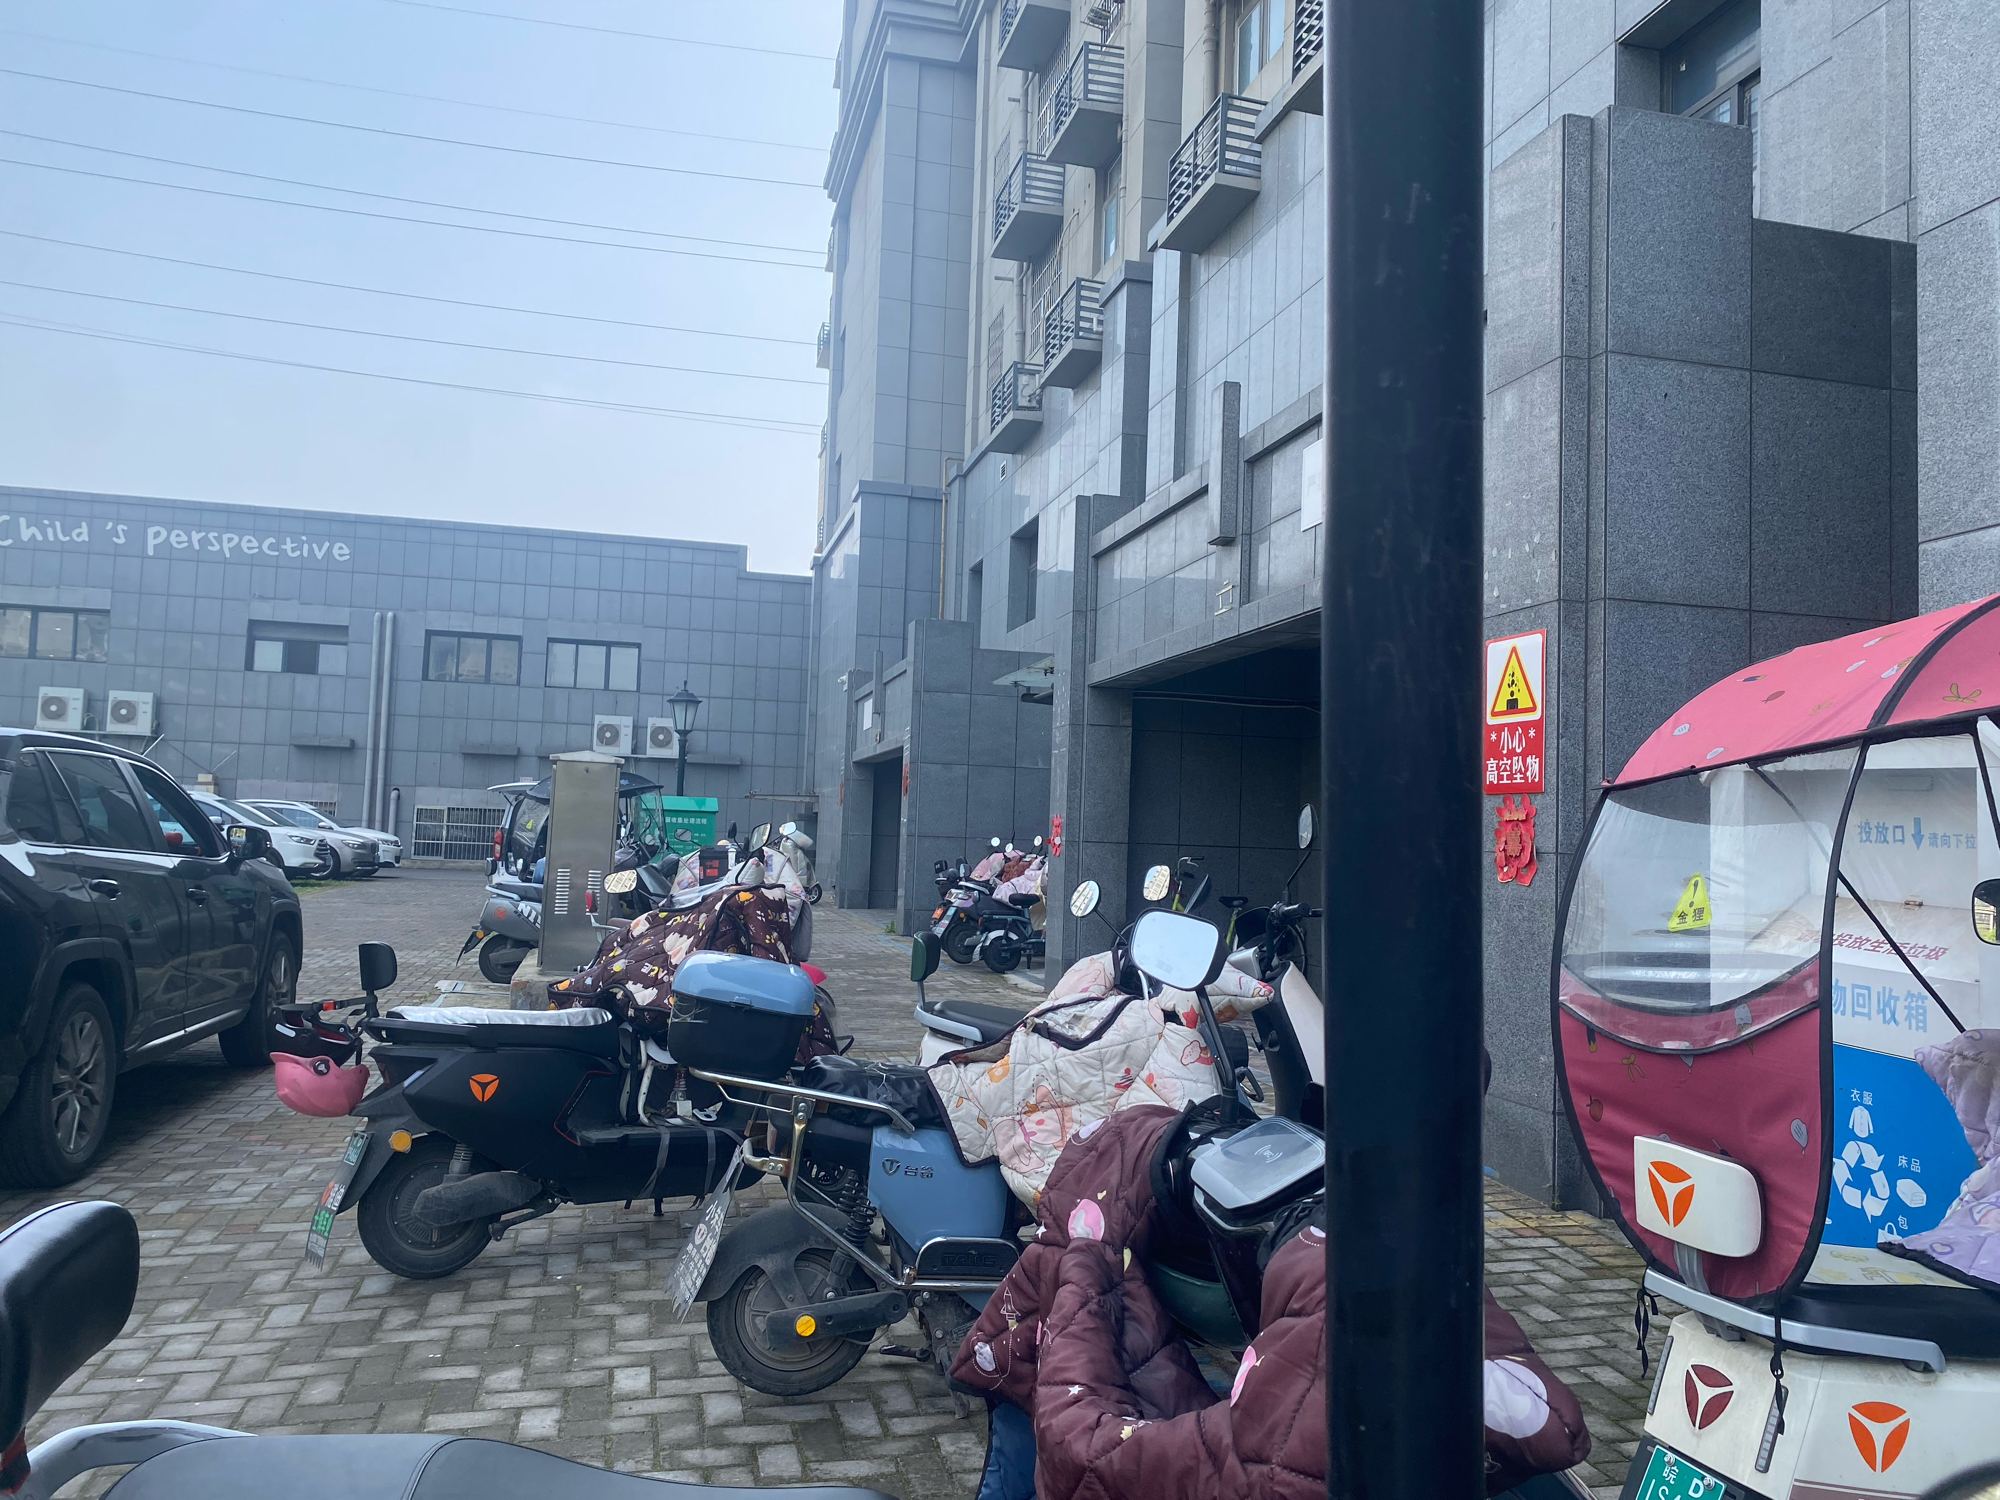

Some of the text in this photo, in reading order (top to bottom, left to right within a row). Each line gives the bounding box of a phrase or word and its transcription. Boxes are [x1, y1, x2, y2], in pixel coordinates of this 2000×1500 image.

[147, 525, 350, 561] perspective
[1486, 755, 1540, 785] 高空坠物
[1857, 820, 1976, 850] 投放口 请向下拉
[1850, 1088, 1873, 1106] 衣服
[1898, 1155, 1921, 1173] 床品
[1898, 1215, 1909, 1230] 包
